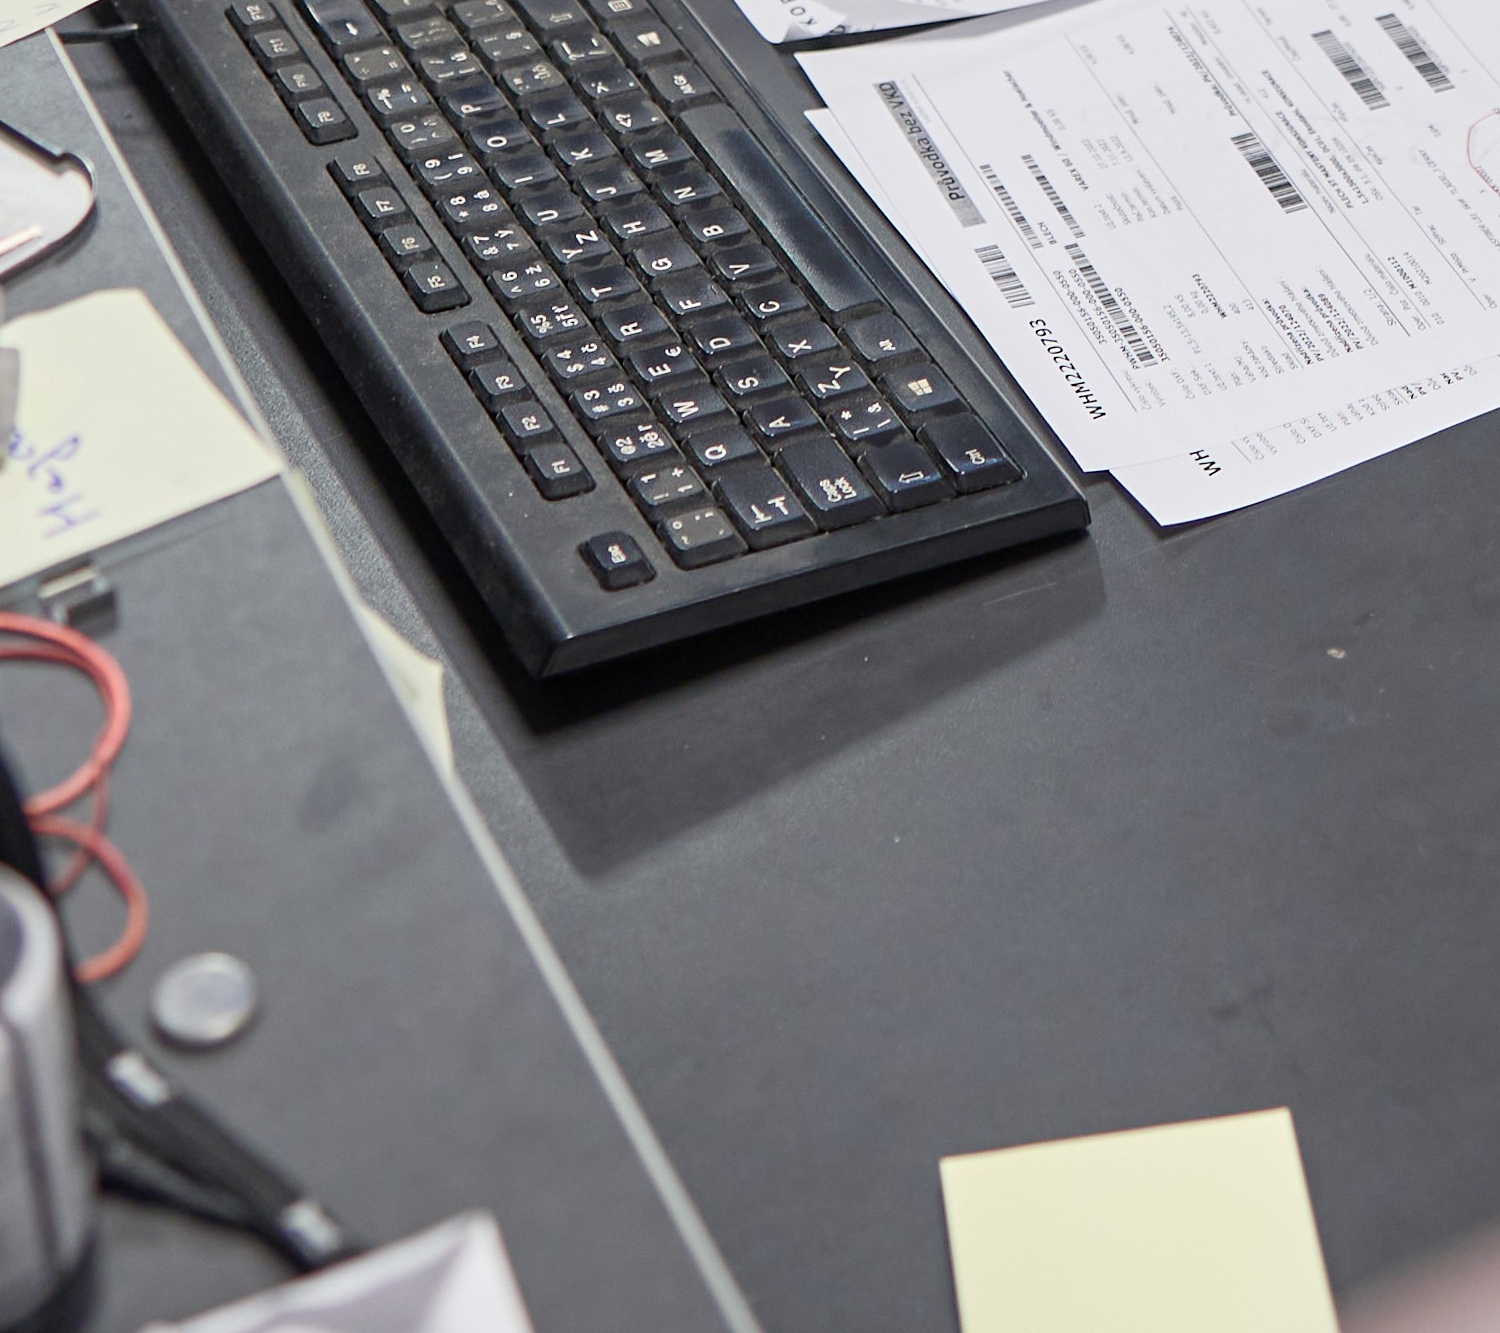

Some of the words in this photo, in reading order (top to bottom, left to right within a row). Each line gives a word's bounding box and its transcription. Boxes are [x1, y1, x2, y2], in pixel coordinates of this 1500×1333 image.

[247, 5, 265, 20] F12
[875, 80, 906, 109] VKD
[1259, 69, 1295, 107] KONSIGNACE
[461, 104, 481, 115] P
[548, 113, 565, 125] L
[894, 110, 923, 135] bez
[1273, 110, 1310, 149] KONSIGNACE
[486, 136, 507, 148] O
[571, 148, 593, 160] K
[645, 149, 669, 164] M
[353, 163, 370, 176] F8
[909, 136, 966, 202] Průvodka
[1067, 167, 1091, 191] VAREX
[1326, 178, 1339, 187] ST
[596, 186, 617, 195] J
[674, 187, 696, 200] N
[1332, 187, 1355, 208] PLECH
[376, 199, 394, 212] F7
[537, 209, 558, 222] U
[623, 221, 646, 234] H
[703, 225, 724, 237] B
[1035, 220, 1058, 245] BLECH
[402, 237, 419, 249] F6
[576, 230, 599, 244] Z
[562, 248, 583, 259] Y
[652, 258, 672, 271] G
[729, 263, 750, 275] V
[1400, 250, 1433, 285] M20210014
[1385, 255, 1418, 290] M1000112
[428, 275, 445, 288] F5
[1380, 279, 1401, 296] Číslo
[591, 283, 613, 297] T
[1190, 272, 1229, 319] WHM2220793
[1361, 287, 1378, 300] 1/2
[679, 299, 701, 310] F
[1241, 298, 1256, 311] 413
[1298, 285, 1331, 319] průvodka:
[1396, 298, 1412, 310] Poz
[1412, 290, 1432, 307] 0010
[759, 300, 780, 313] C
[1051, 268, 1109, 344] 35050156-000-0550
[1228, 301, 1242, 315] 400
[1372, 300, 1398, 326] Strana:
[1065, 267, 1142, 370] PWHM-35050156-000-0550
[1258, 296, 1291, 331] průvodka:
[1315, 291, 1365, 350] PV/2022/124089
[1429, 311, 1446, 325] 010
[620, 322, 643, 336] R
[1112, 286, 1171, 362] 35050156-000-0550
[1408, 314, 1428, 331] Oper
[1277, 303, 1326, 362] PV/2022/124070
[1356, 324, 1380, 346] Důvod
[466, 335, 484, 348] F4
[709, 337, 731, 350] D
[788, 339, 812, 353] X
[880, 338, 896, 351] Alt
[1317, 336, 1341, 358] Důvod
[1279, 351, 1299, 370] Sklad
[649, 364, 671, 377] E
[829, 365, 851, 379] Y
[1027, 316, 1108, 420] WHM2220793
[495, 375, 513, 389] F3
[738, 376, 759, 388] S
[817, 379, 841, 393] Z
[673, 401, 699, 417] W
[522, 415, 540, 431] F2
[769, 415, 791, 429] A
[705, 444, 726, 459] Q
[965, 448, 985, 465] Ctrl
[552, 460, 570, 473] F1
